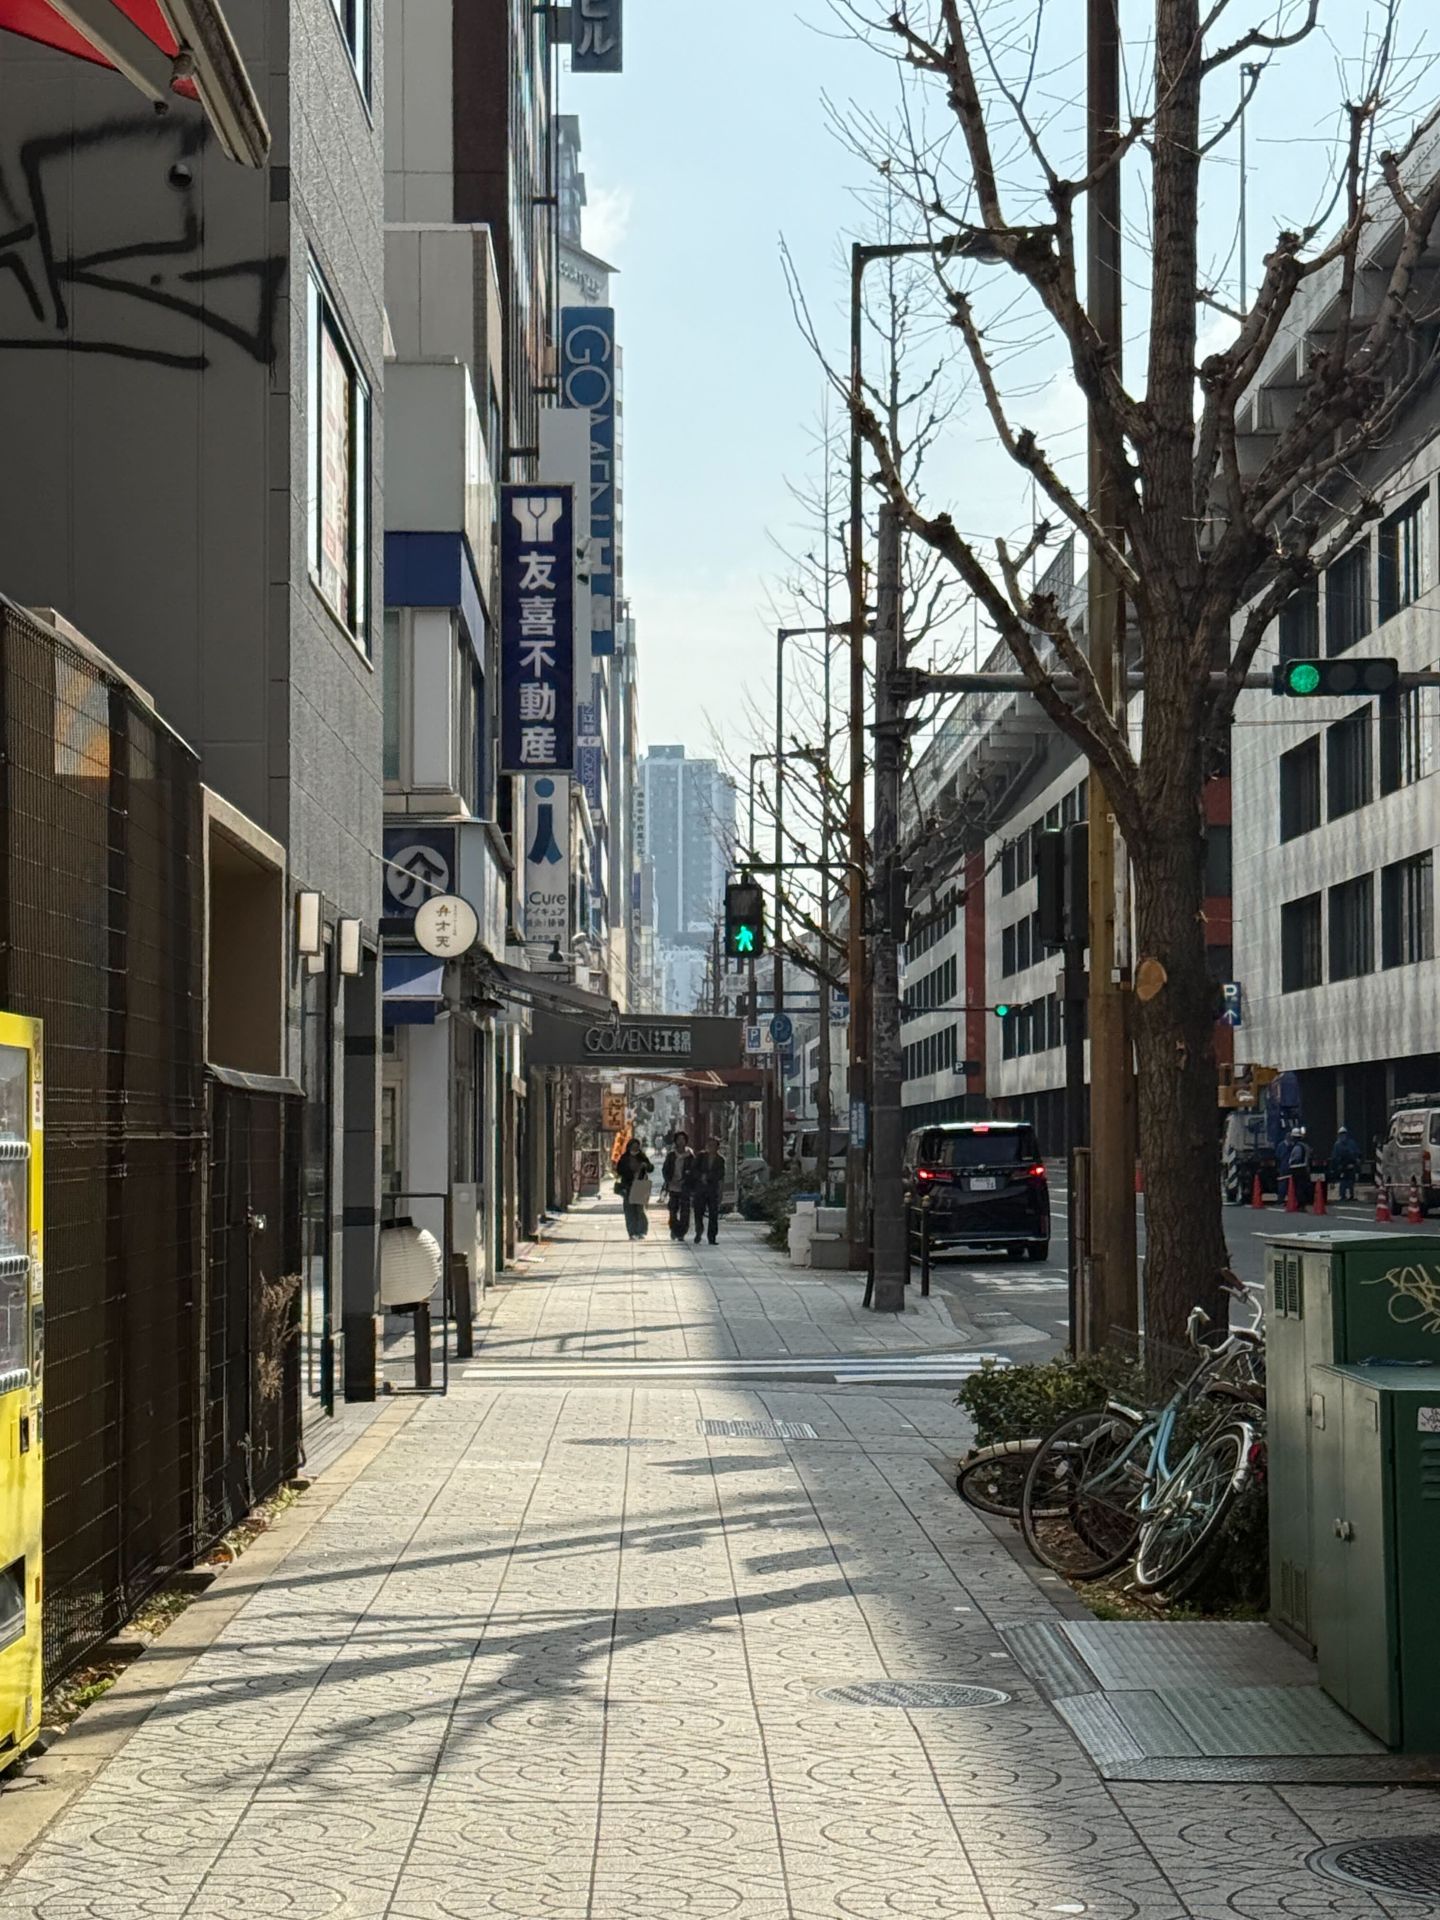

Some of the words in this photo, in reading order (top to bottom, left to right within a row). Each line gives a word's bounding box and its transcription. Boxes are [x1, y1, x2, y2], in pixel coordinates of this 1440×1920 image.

[518, 552, 557, 763] 友喜不動産
[435, 904, 452, 948] 弁才天
